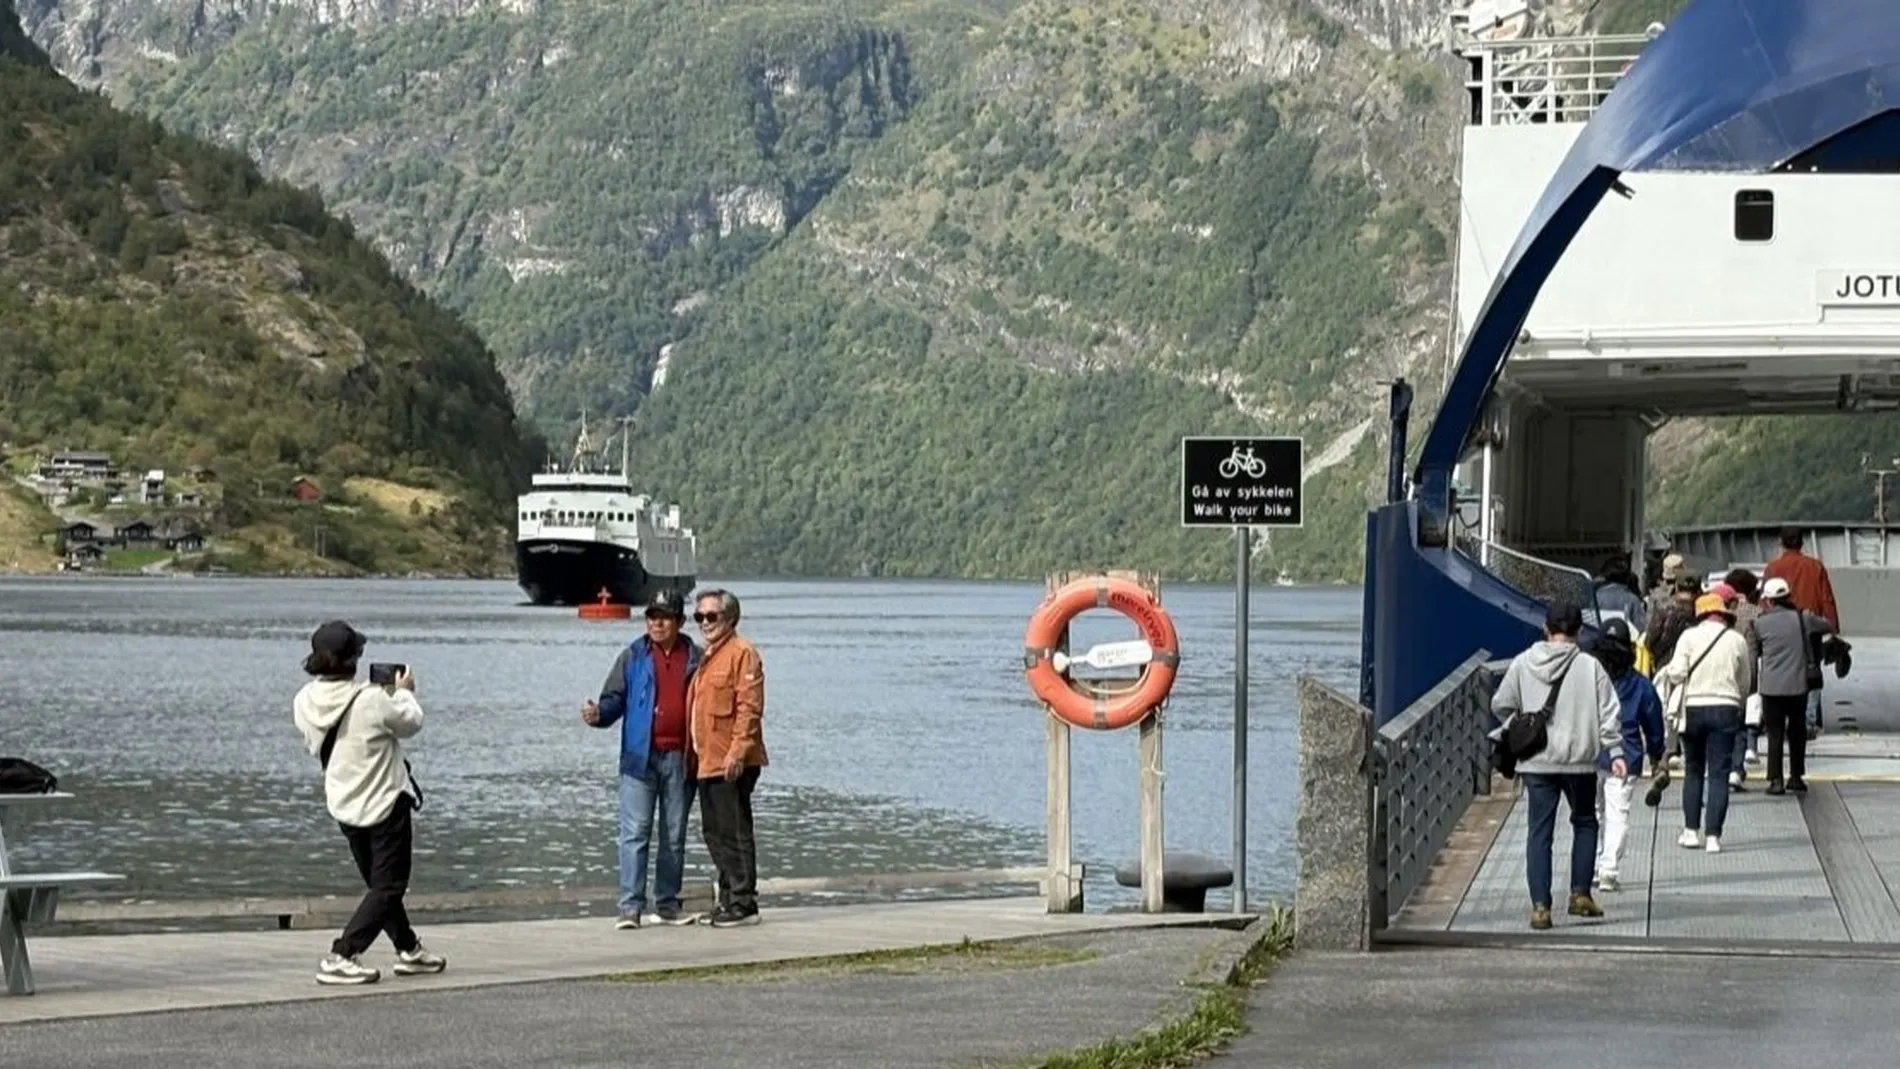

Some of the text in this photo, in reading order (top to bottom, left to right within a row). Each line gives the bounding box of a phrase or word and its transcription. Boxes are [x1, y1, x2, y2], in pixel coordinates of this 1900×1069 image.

[1836, 275, 1900, 298] JOT
[1192, 484, 1293, 500] Gå av sykkelen
[1194, 503, 1292, 519] Walk your bike
